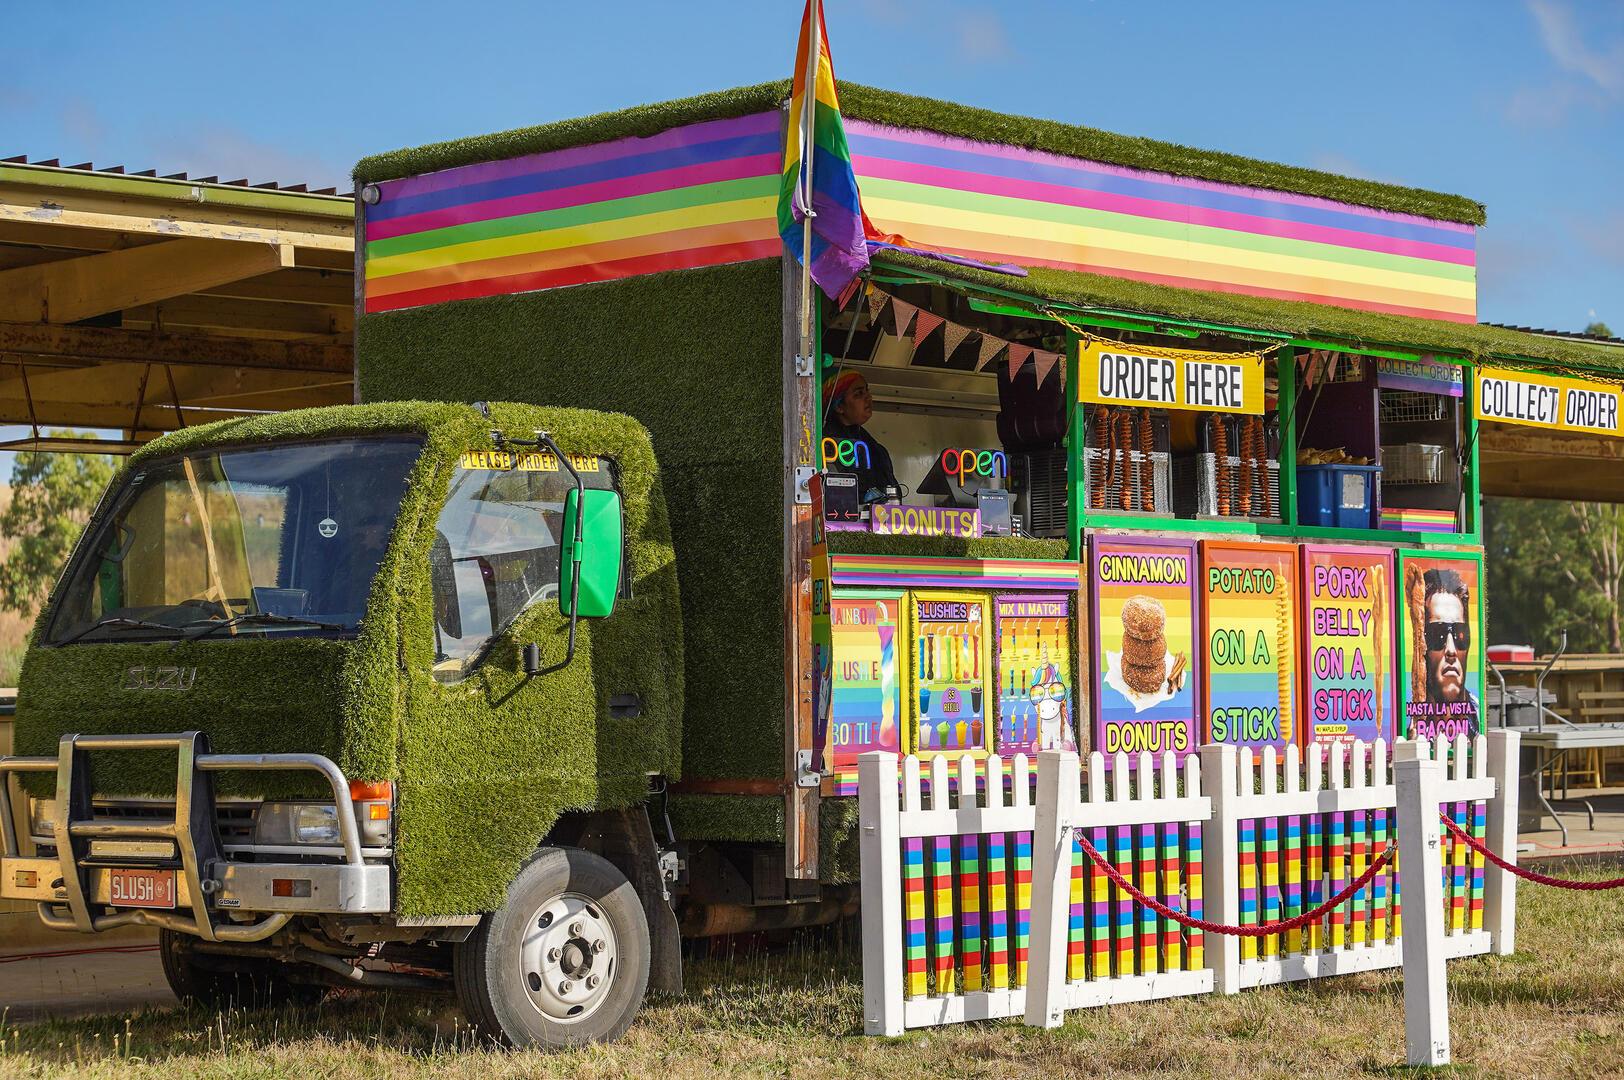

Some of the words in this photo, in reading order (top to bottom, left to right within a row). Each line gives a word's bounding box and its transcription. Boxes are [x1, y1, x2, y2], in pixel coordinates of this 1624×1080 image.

[1099, 353, 1176, 402] ORDER
[1186, 362, 1241, 407] HERE
[1377, 358, 1425, 377] COLLECT
[1429, 364, 1462, 382] ORDER
[1481, 378, 1559, 423] COLLECT
[1565, 388, 1618, 430] ORDER
[461, 451, 510, 469] PLEASE
[517, 453, 558, 470] ORDER
[820, 436, 871, 472] pen
[941, 448, 1008, 488] open
[890, 506, 979, 538] DONUTS!
[1099, 555, 1187, 583] CINNAMON
[1208, 567, 1276, 594] POTATO
[1314, 565, 1368, 599] PORK
[917, 602, 967, 619] SLUSHIES
[999, 603, 1015, 615] MIX
[1017, 603, 1026, 615] N
[1028, 603, 1061, 616] MATCH
[1314, 607, 1371, 636] BELLY
[1211, 629, 1246, 665] ON
[1252, 629, 1271, 665] A
[1314, 646, 1344, 680] ON
[1351, 647, 1366, 680] A
[1315, 688, 1373, 721] STICK
[1406, 702, 1434, 716] HASTA
[1436, 703, 1447, 716] LA
[1106, 720, 1188, 753] DONUTS
[1211, 707, 1277, 742] STICK
[112, 875, 154, 901] SLUSH
[166, 878, 172, 902] 1
